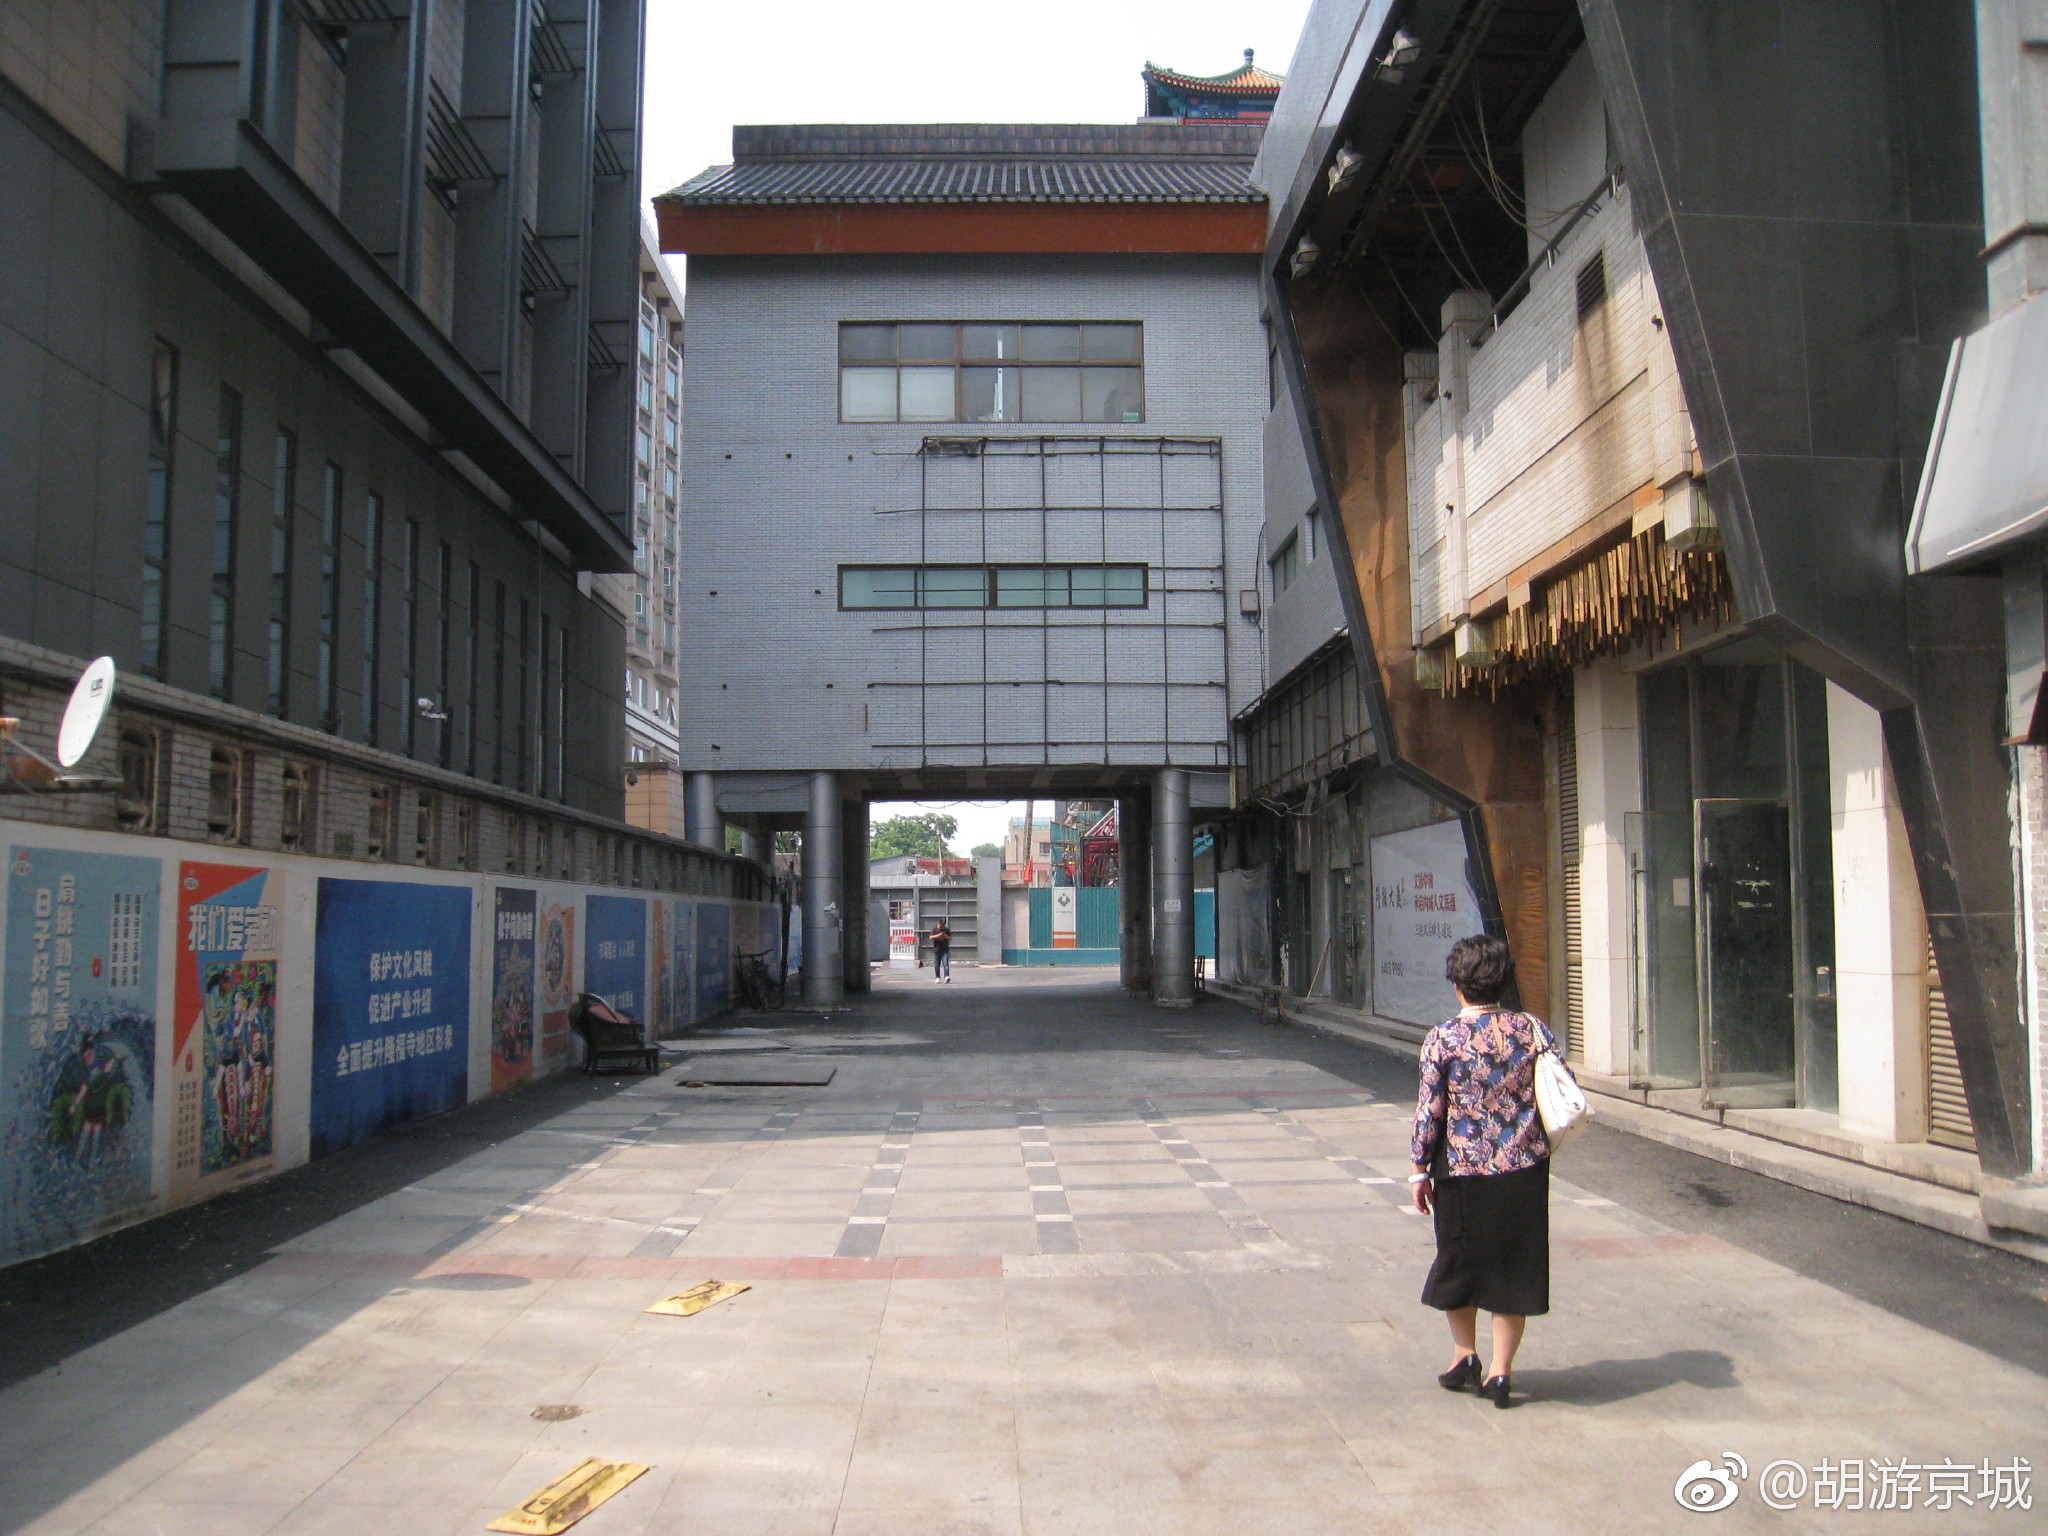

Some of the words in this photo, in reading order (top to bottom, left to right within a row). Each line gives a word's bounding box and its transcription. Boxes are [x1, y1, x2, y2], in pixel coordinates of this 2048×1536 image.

[187, 903, 277, 952] 我们爱劳动
[370, 950, 433, 982] 保护文化风貌
[368, 988, 432, 1024] 促进产业升级
[336, 1024, 453, 1076] 全面提升隆福寺地区形象
